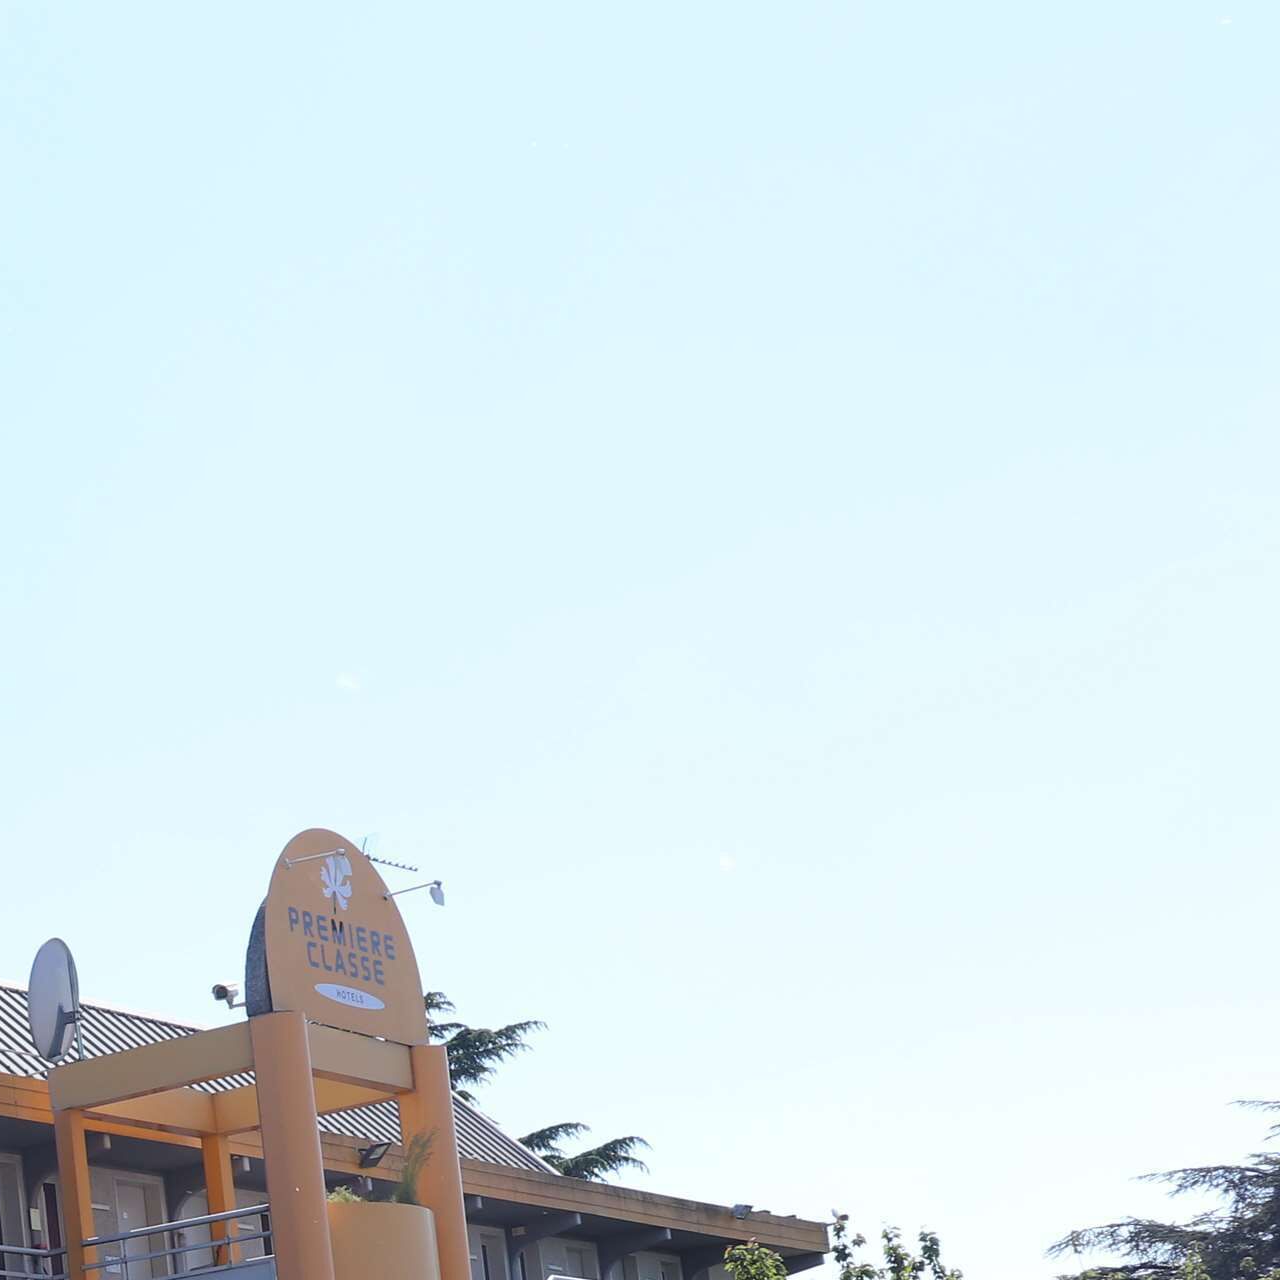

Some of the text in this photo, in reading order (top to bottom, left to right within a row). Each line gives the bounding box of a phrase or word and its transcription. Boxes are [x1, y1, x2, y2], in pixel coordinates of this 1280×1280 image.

[288, 906, 396, 961] PREMIERE
[306, 941, 385, 986] CLASSE
[336, 989, 364, 1004] HOTELS
